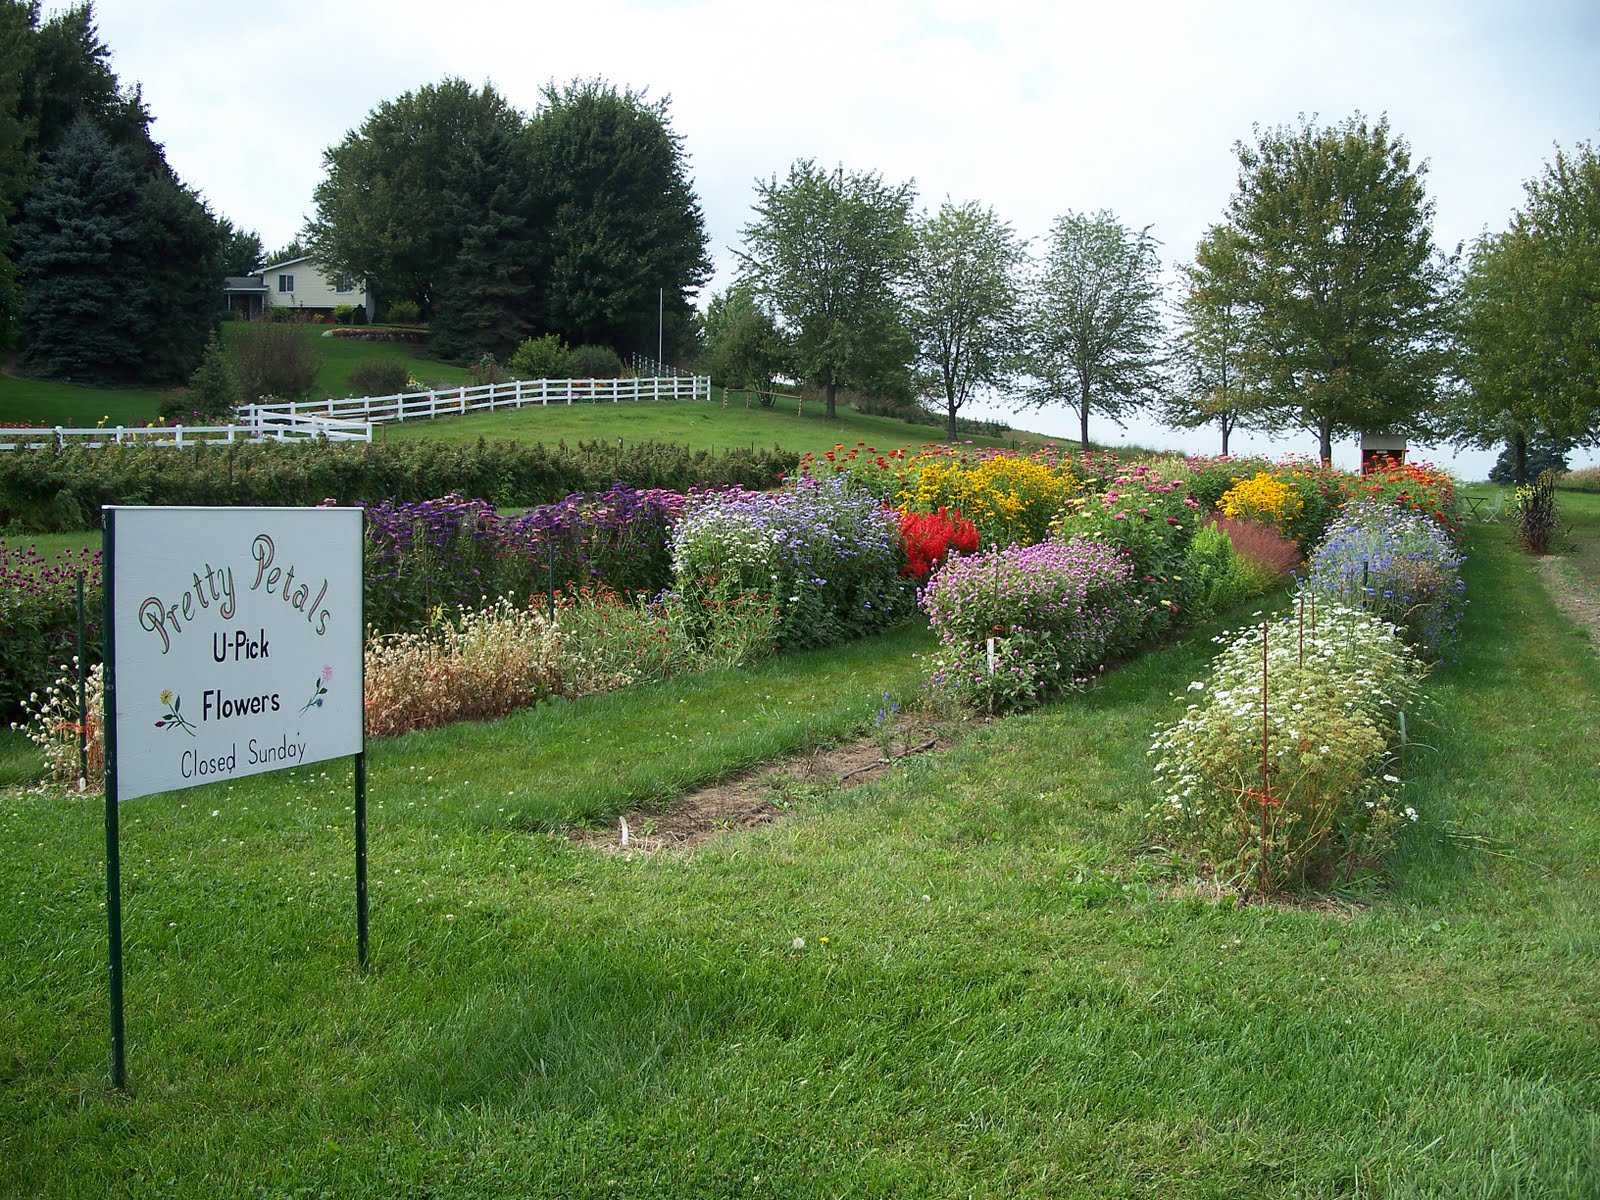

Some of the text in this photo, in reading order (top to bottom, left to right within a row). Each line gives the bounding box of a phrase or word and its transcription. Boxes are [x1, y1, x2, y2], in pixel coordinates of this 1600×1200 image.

[138, 534, 331, 655] Pretty Petals
[213, 628, 270, 663] U-Pick
[203, 689, 281, 722] Flowers
[181, 734, 306, 779] Closed Sunday
